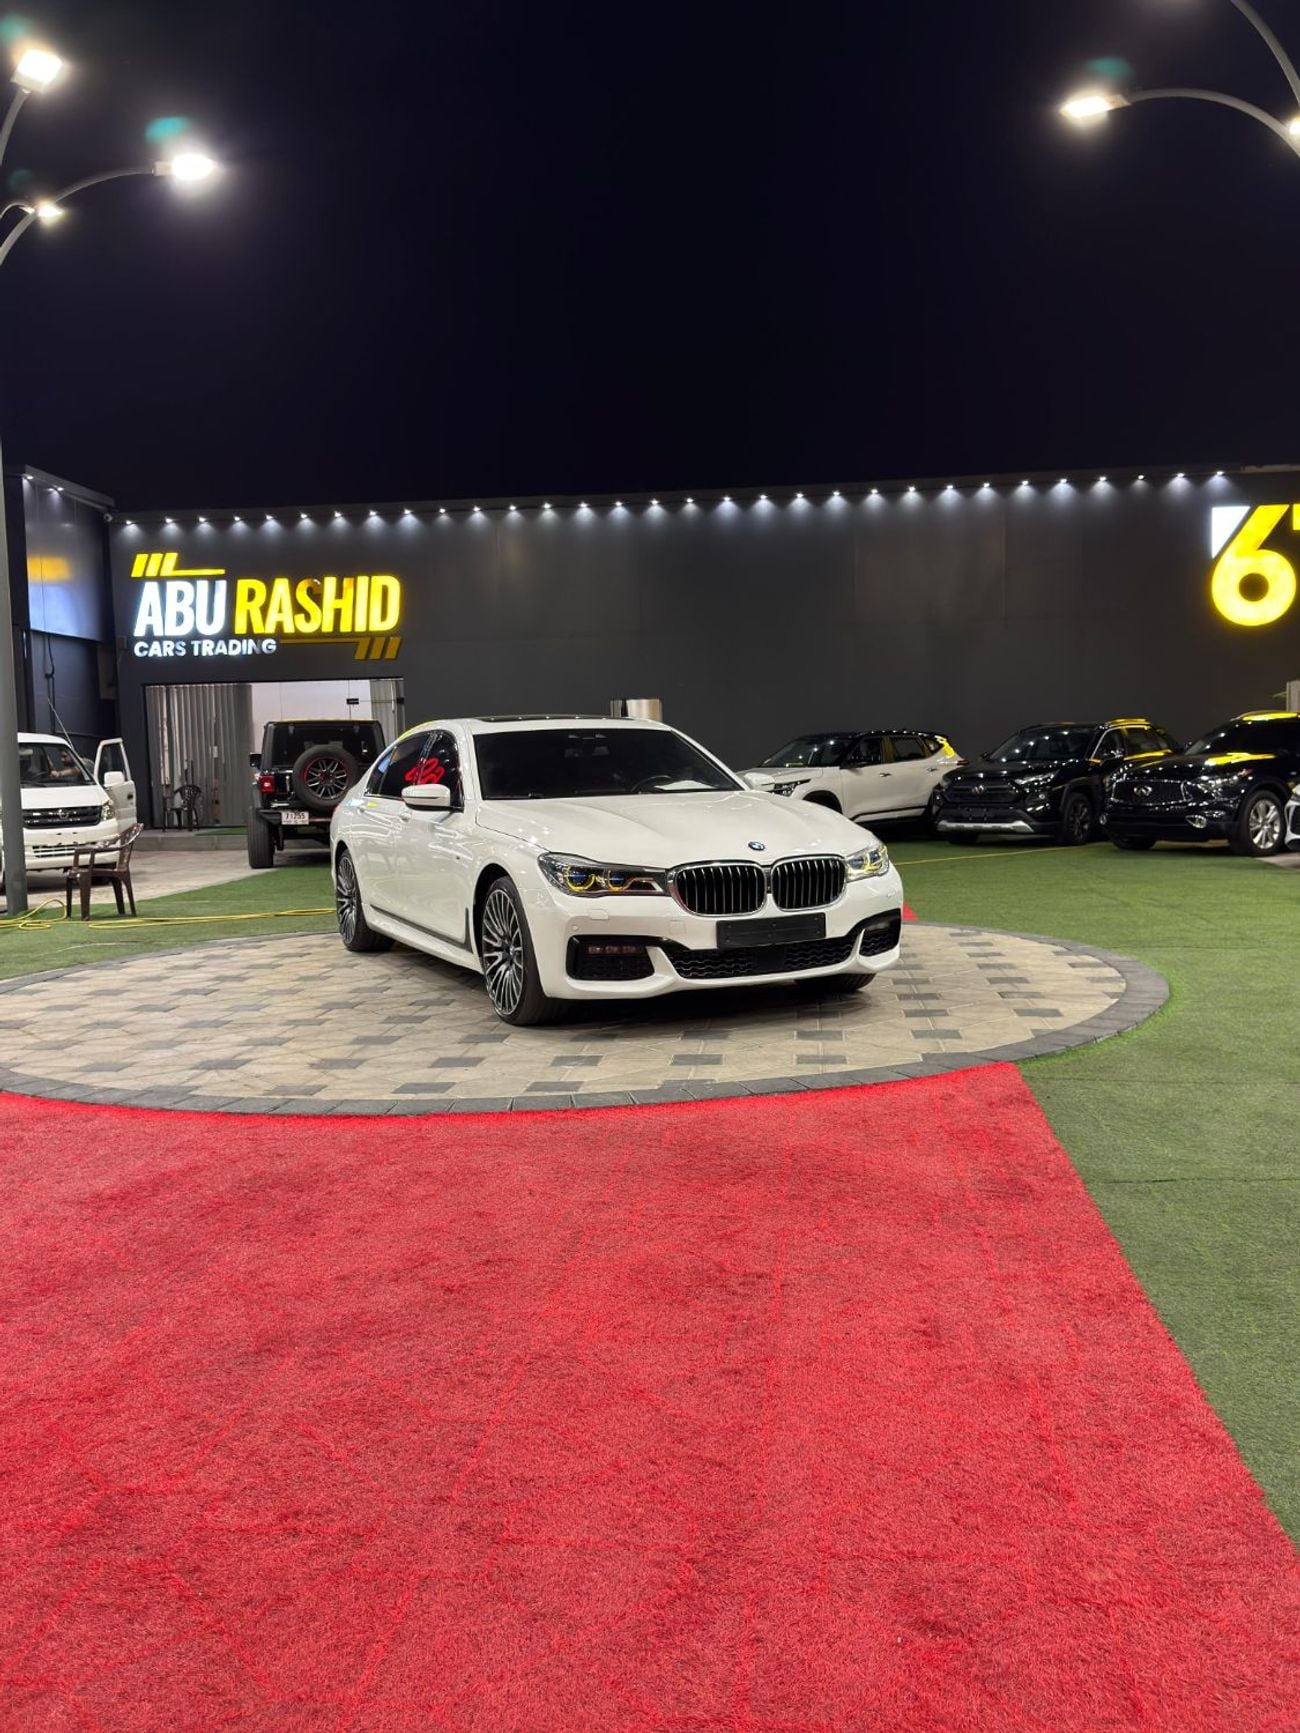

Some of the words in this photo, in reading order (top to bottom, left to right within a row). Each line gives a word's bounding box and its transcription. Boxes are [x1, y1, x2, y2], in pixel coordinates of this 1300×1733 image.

[133, 580, 227, 637] ABU
[234, 575, 401, 634] RASHID
[134, 641, 186, 657] CARS
[190, 638, 277, 656] TRADING
